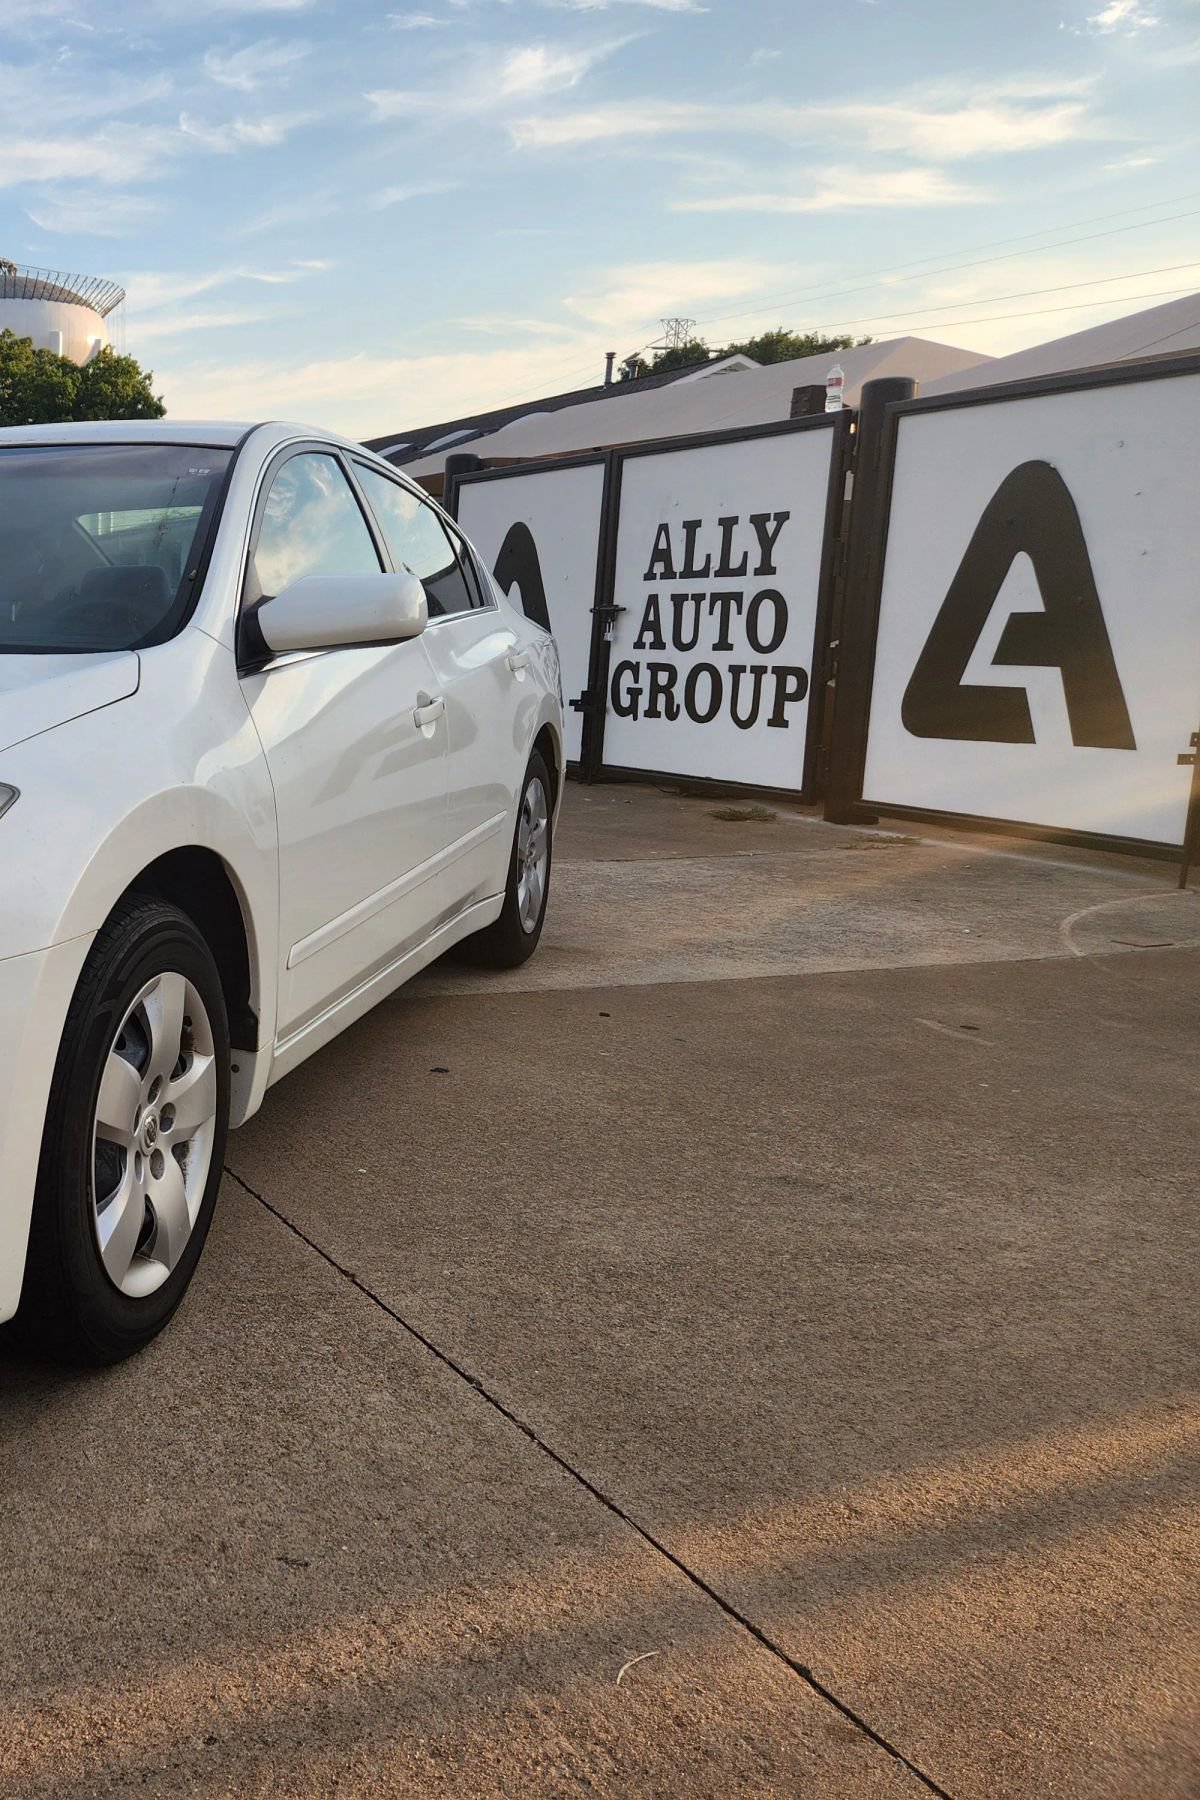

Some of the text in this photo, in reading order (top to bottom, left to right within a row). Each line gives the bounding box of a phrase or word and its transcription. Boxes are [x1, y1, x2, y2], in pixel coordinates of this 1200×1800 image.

[643, 511, 790, 581] ALLY
[633, 589, 788, 654] AUTO
[611, 660, 808, 729] GROUP
